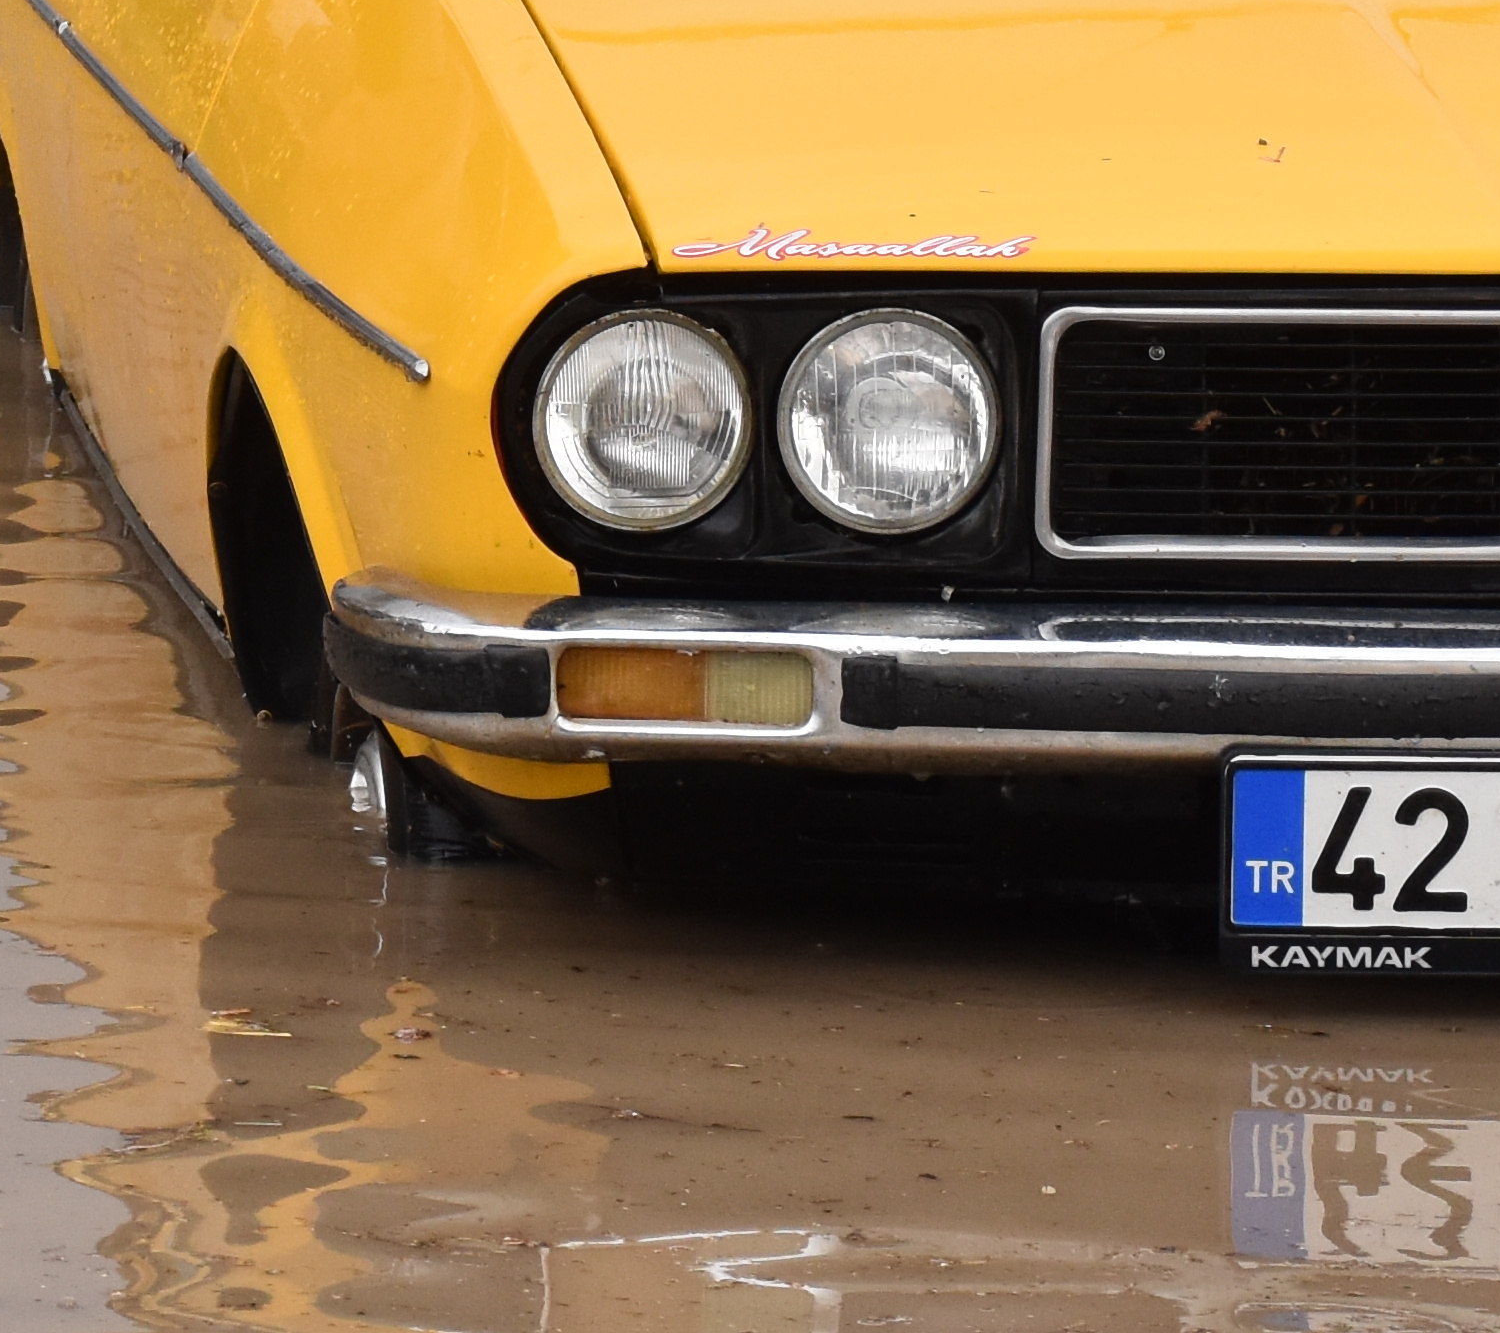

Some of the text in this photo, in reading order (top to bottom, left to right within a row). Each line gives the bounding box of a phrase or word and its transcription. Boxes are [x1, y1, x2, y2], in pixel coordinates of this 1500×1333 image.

[1310, 785, 1470, 913] 42
[1245, 859, 1295, 894] TR
[1250, 944, 1433, 970] KAYMAK
